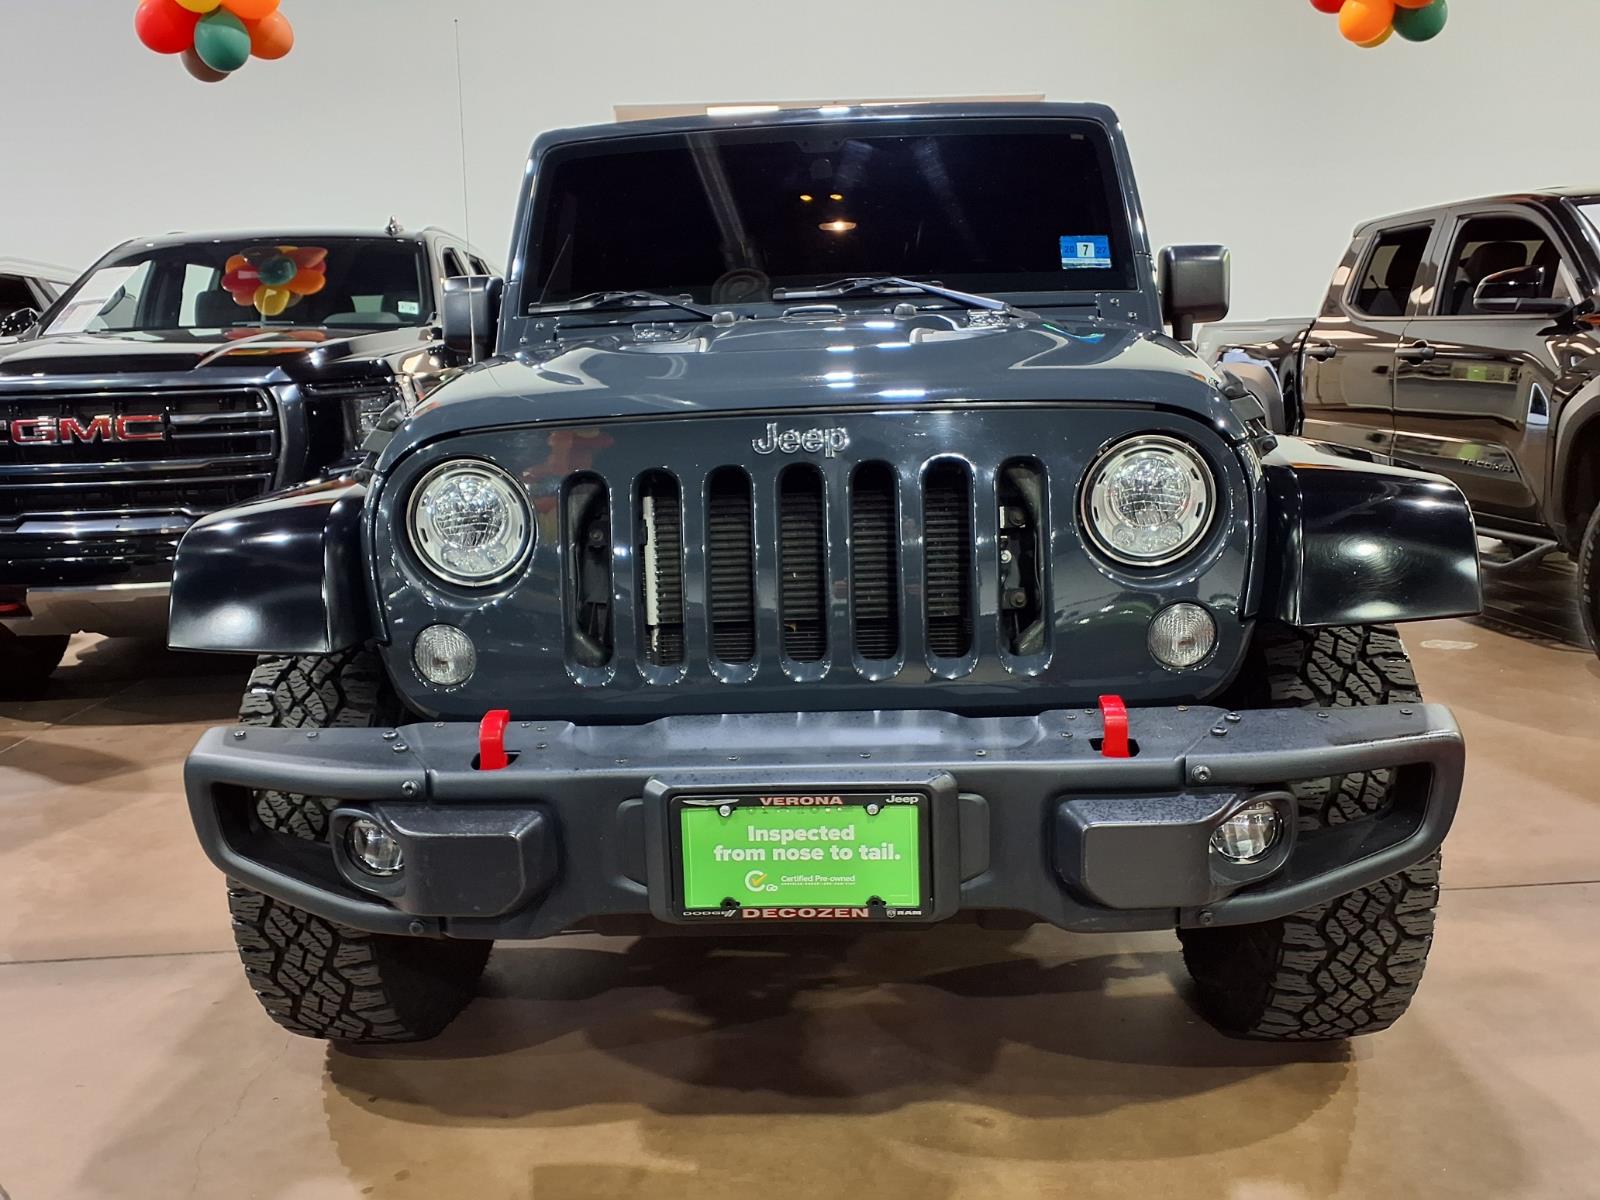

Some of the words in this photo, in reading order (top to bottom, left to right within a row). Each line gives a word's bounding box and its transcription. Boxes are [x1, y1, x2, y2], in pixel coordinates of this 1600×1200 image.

[1082, 244, 1089, 257] 7
[10, 415, 166, 446] GMC
[752, 422, 850, 458] Jeep
[1460, 457, 1514, 474] TACOMA
[759, 796, 844, 806] VERONA
[885, 795, 919, 804] Jeep
[747, 825, 855, 845] Inspected
[713, 845, 765, 861] from
[772, 847, 824, 861] nose
[829, 845, 853, 860] to
[858, 842, 901, 861] tail.
[780, 875, 813, 883] Certified
[815, 875, 856, 883] Pre-owned
[742, 908, 870, 918] DECOZEN
